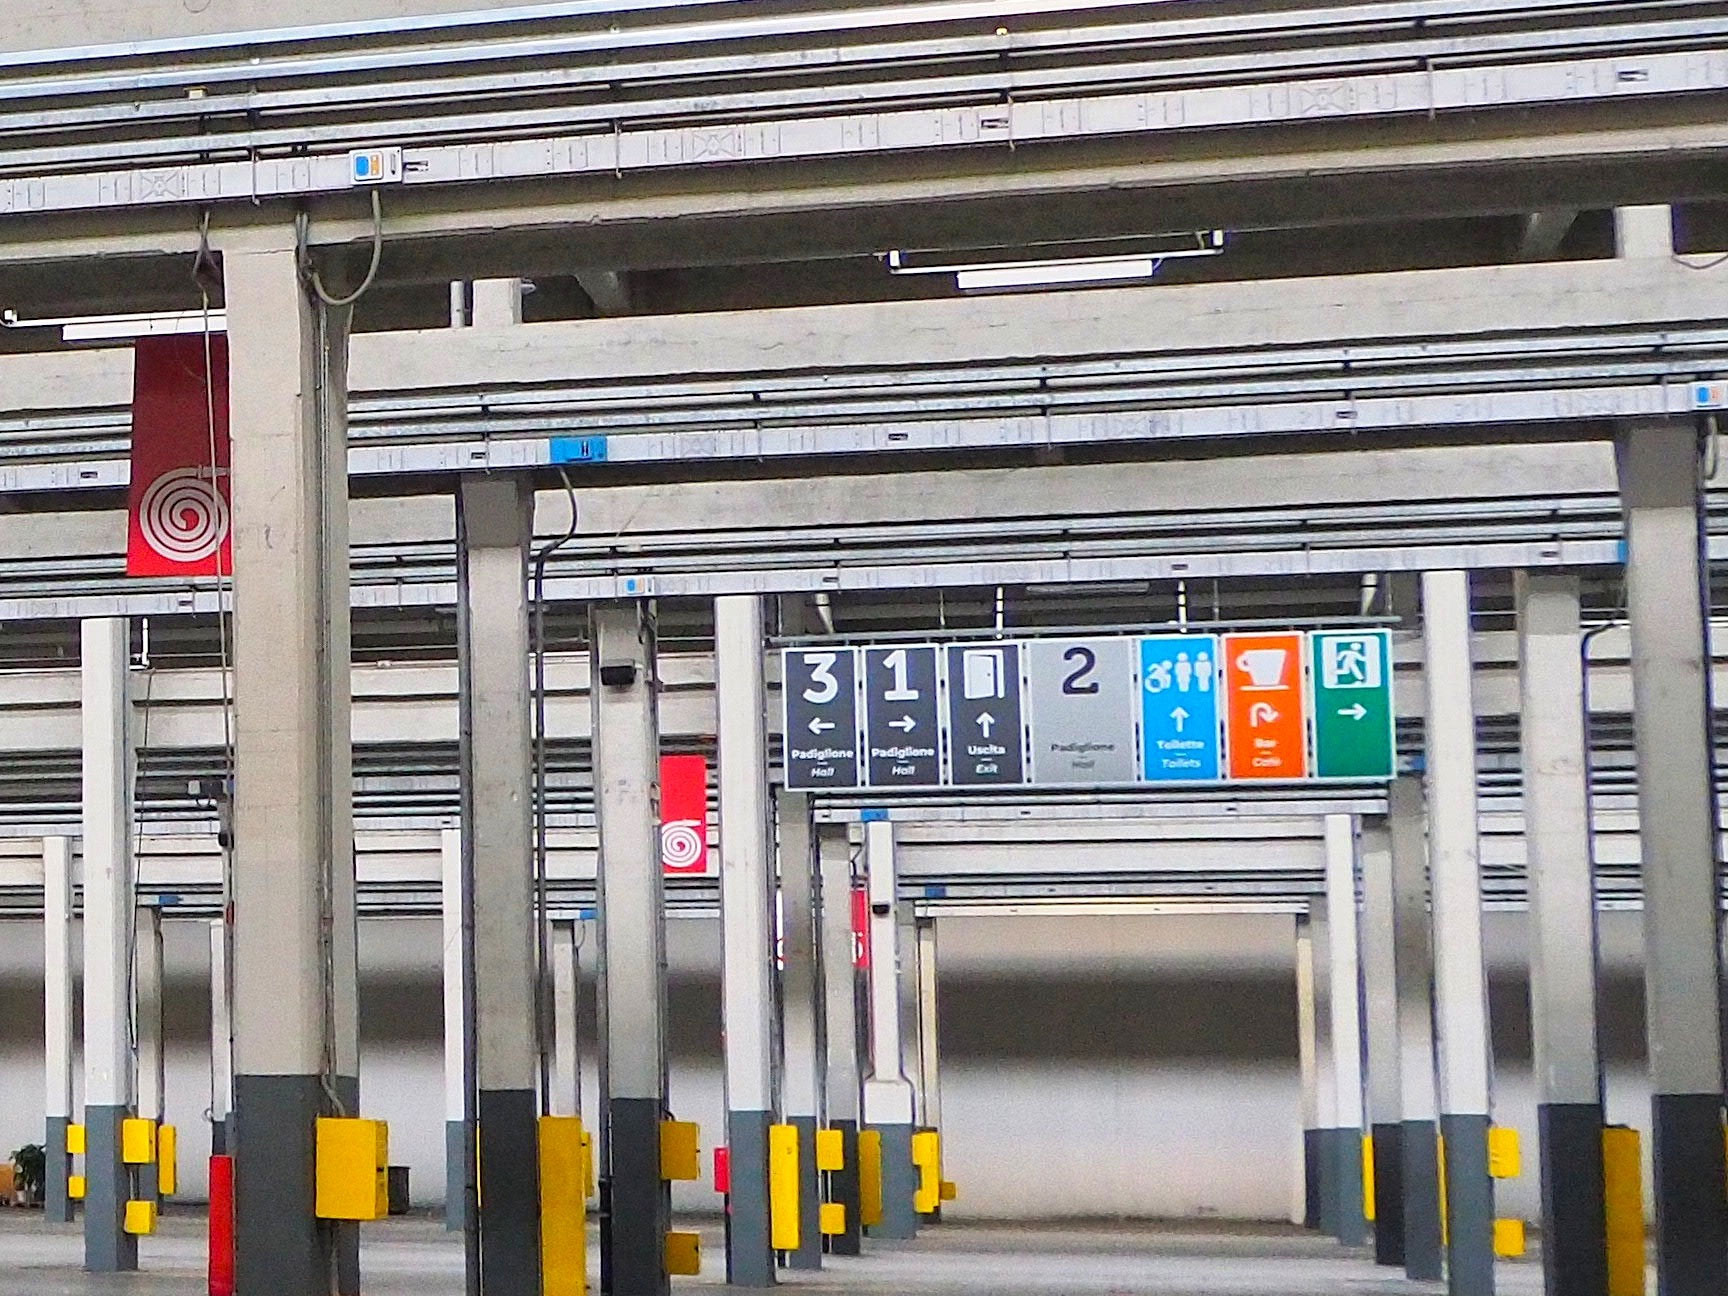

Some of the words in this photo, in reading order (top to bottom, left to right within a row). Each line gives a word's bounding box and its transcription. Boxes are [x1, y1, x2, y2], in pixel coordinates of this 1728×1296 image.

[883, 650, 919, 701] 1
[1062, 647, 1099, 695] 2
[803, 653, 839, 704] 3
[791, 748, 854, 761] Padiglione
[871, 747, 935, 760] Padiglione
[968, 744, 1006, 755] Uscita
[811, 767, 834, 778] Hall
[892, 766, 915, 776] Hall
[975, 764, 998, 774] Exit
